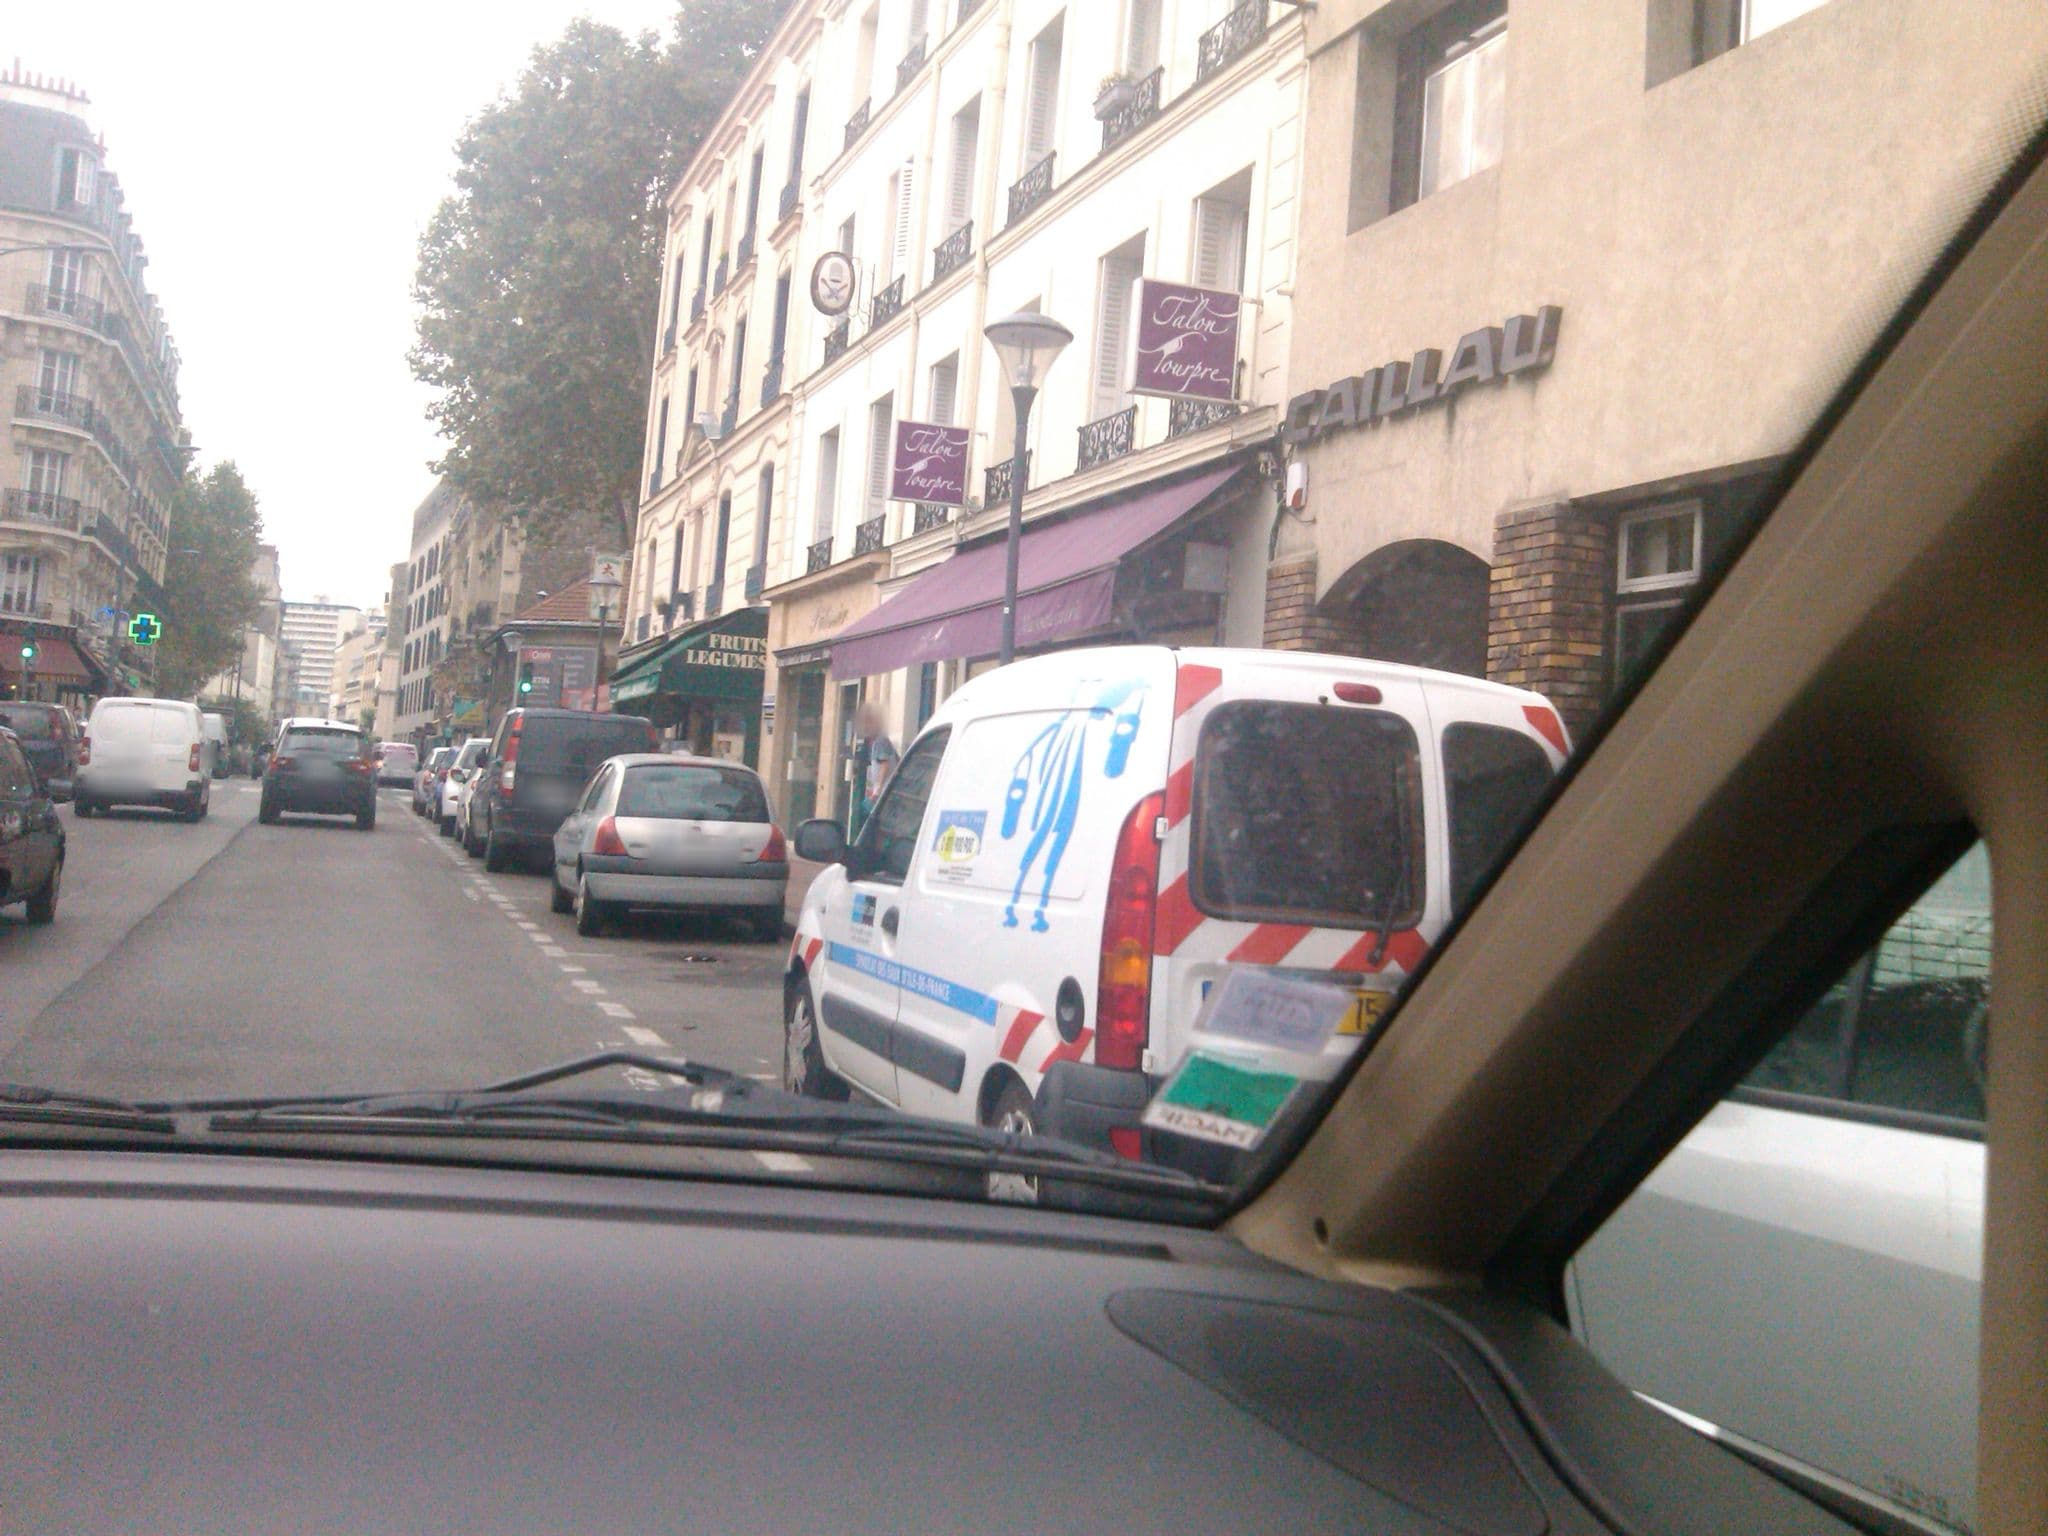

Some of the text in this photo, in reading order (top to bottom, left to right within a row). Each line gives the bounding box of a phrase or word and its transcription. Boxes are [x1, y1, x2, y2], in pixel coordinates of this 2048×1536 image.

[1152, 292, 1239, 335] Talon
[1283, 304, 1563, 444] CAILLAU
[905, 427, 969, 457] Talon
[709, 633, 768, 653] FRUITS
[686, 649, 768, 670] LEGUMES
